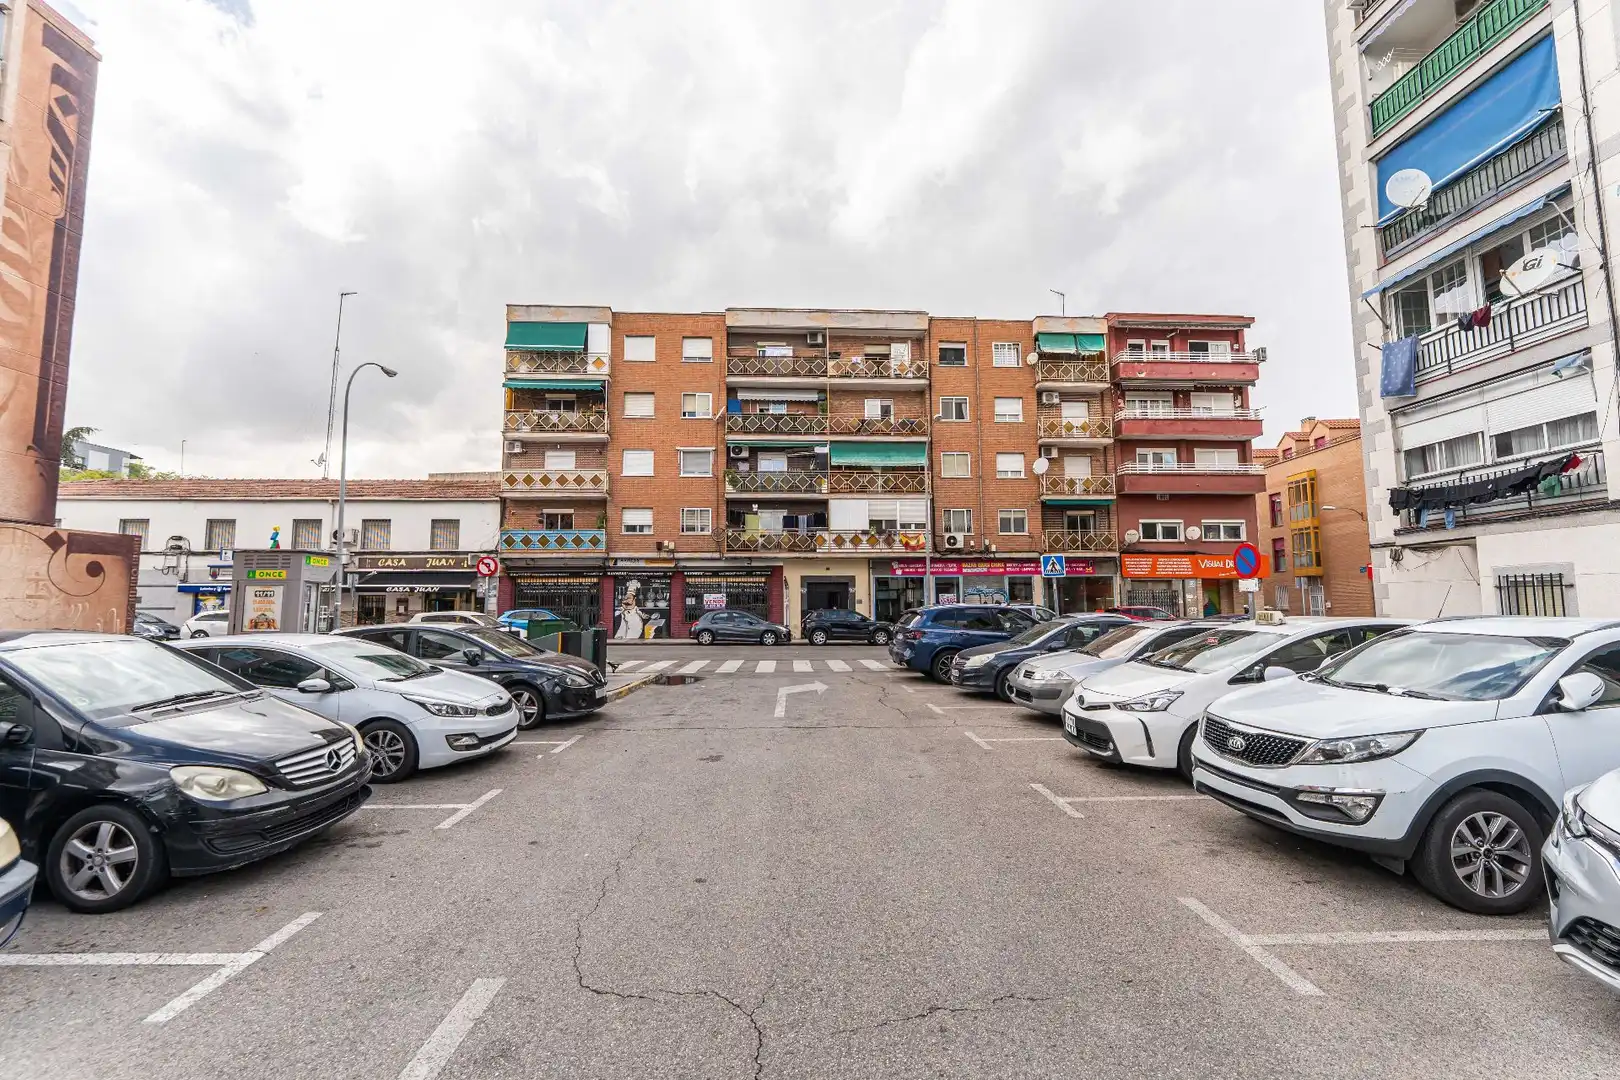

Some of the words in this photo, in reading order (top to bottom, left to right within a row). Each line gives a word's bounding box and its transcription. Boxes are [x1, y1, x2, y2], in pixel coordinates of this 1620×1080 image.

[312, 558, 327, 566] ONCE
[378, 558, 407, 567] CASA
[426, 558, 456, 568] JUAN
[1198, 559, 1225, 568] VISUAL
[1228, 738, 1242, 748] KIA
